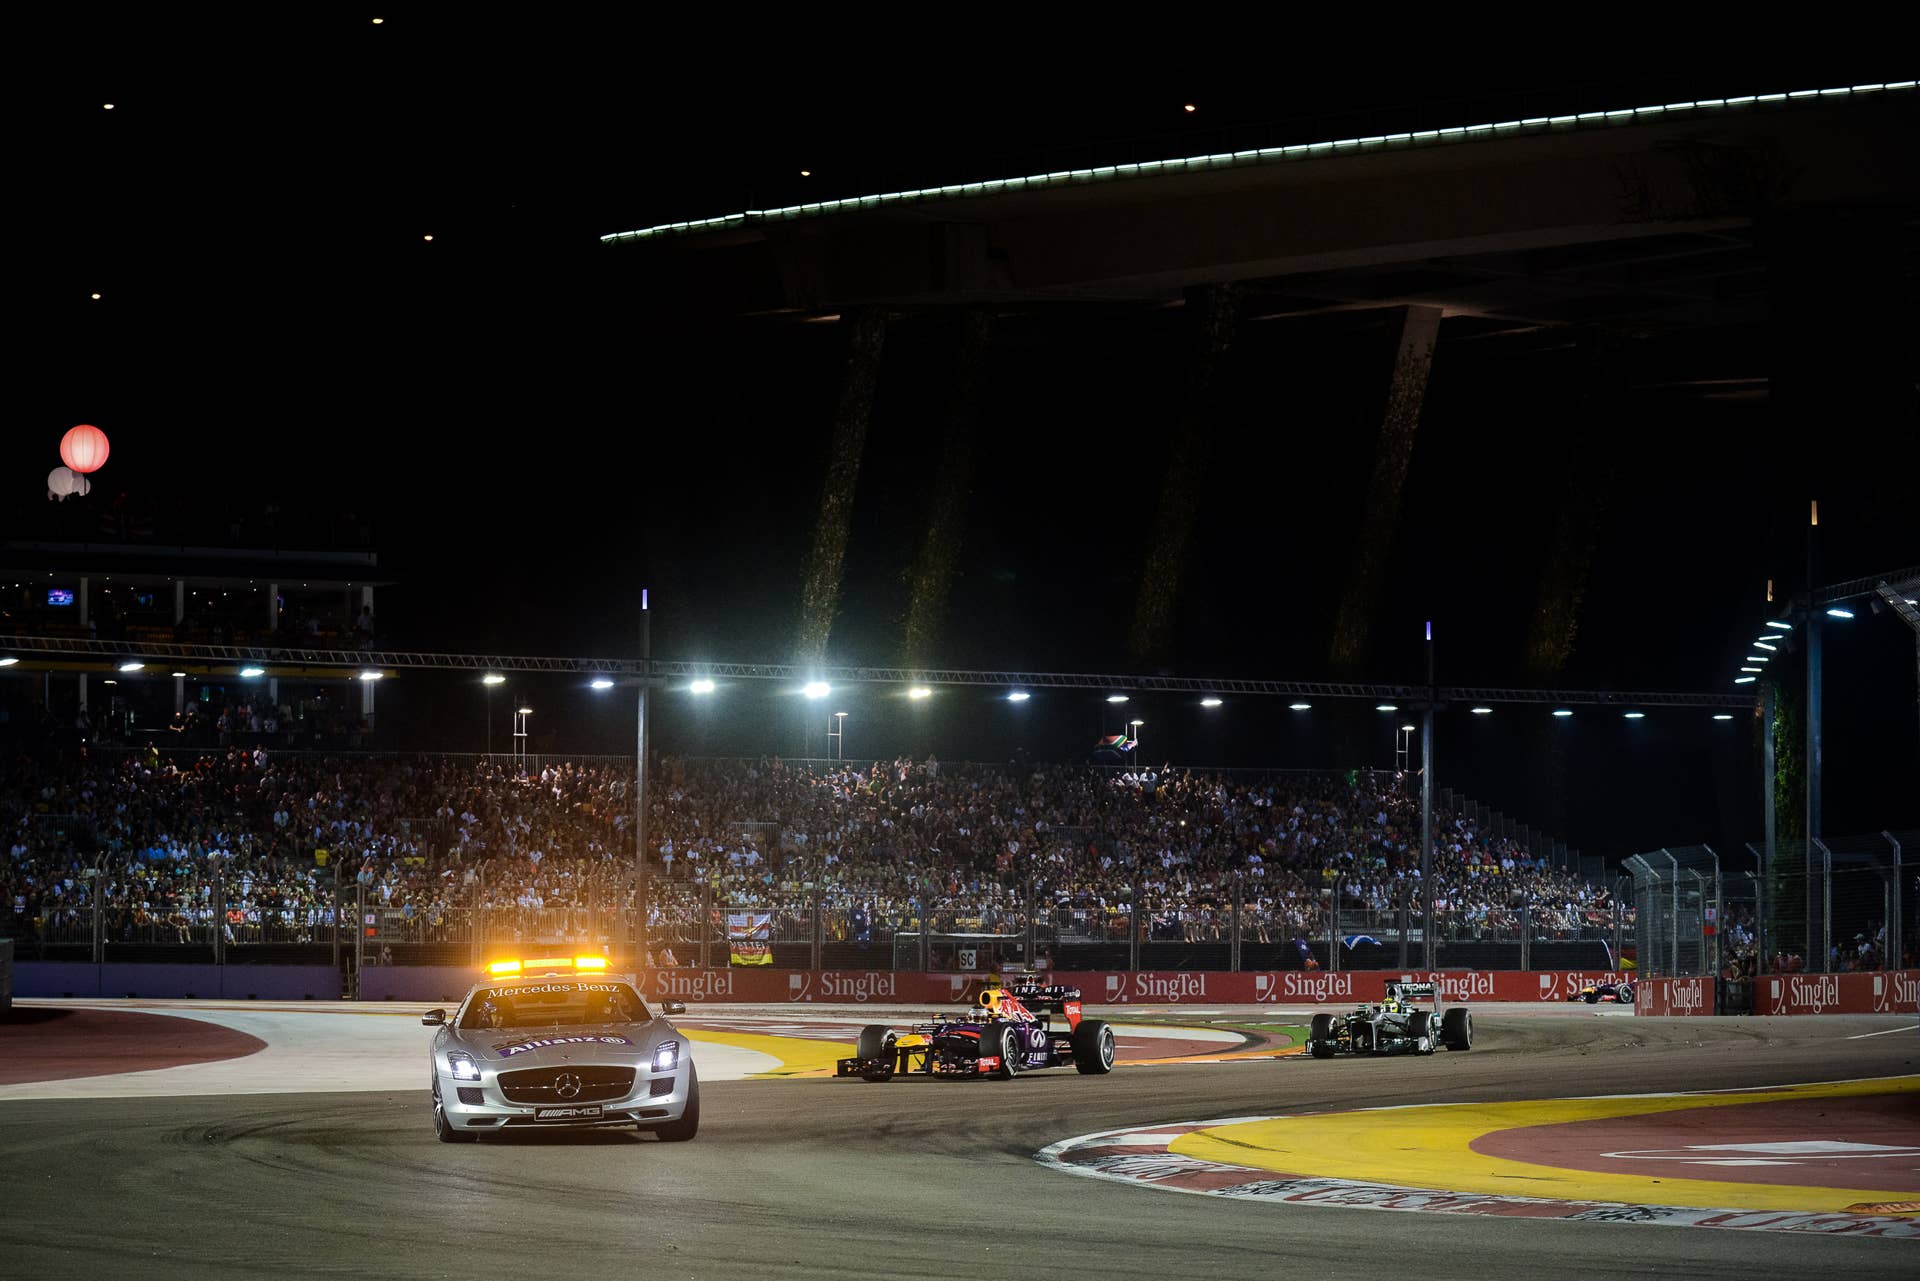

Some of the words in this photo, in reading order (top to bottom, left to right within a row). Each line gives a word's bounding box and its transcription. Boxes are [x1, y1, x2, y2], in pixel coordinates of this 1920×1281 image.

[960, 953, 975, 966] SC
[487, 982, 620, 999] Mercedes-Benz
[656, 971, 734, 1001] SingTel
[820, 972, 896, 1002] SingTel
[1135, 973, 1207, 1002] SingTel
[1284, 973, 1353, 1002] SingTel
[1672, 979, 1703, 1016] SingTel
[1790, 975, 1840, 1014] SingTel
[1894, 972, 1920, 1009] Sin
[509, 1036, 598, 1055] Allianz
[559, 1107, 601, 1117] AMG
